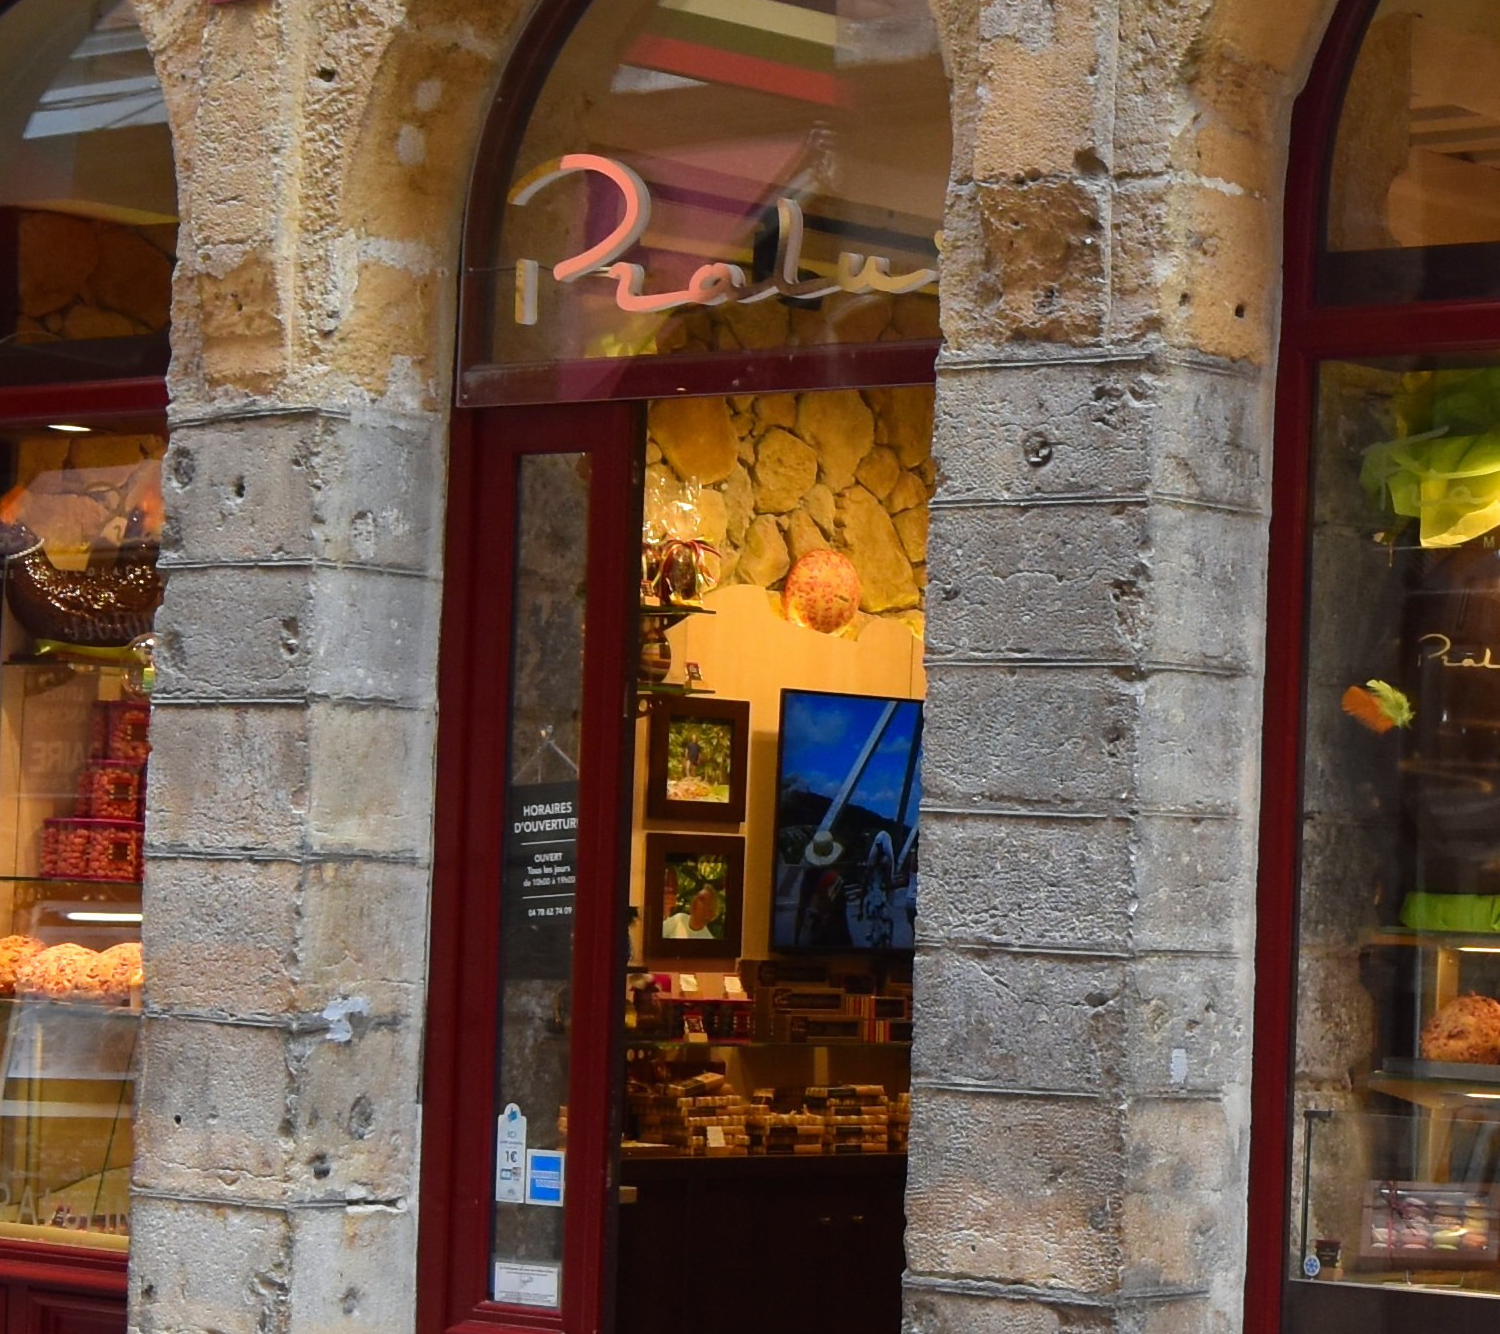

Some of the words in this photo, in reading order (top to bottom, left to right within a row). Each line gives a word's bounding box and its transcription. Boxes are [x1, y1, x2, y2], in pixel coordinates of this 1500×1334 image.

[506, 153, 942, 327] Pralu
[523, 802, 572, 817] HORAIRES
[514, 817, 579, 834] D'OUVERTUR
[534, 852, 563, 863] OUVERT
[505, 1150, 518, 1164] 1€
